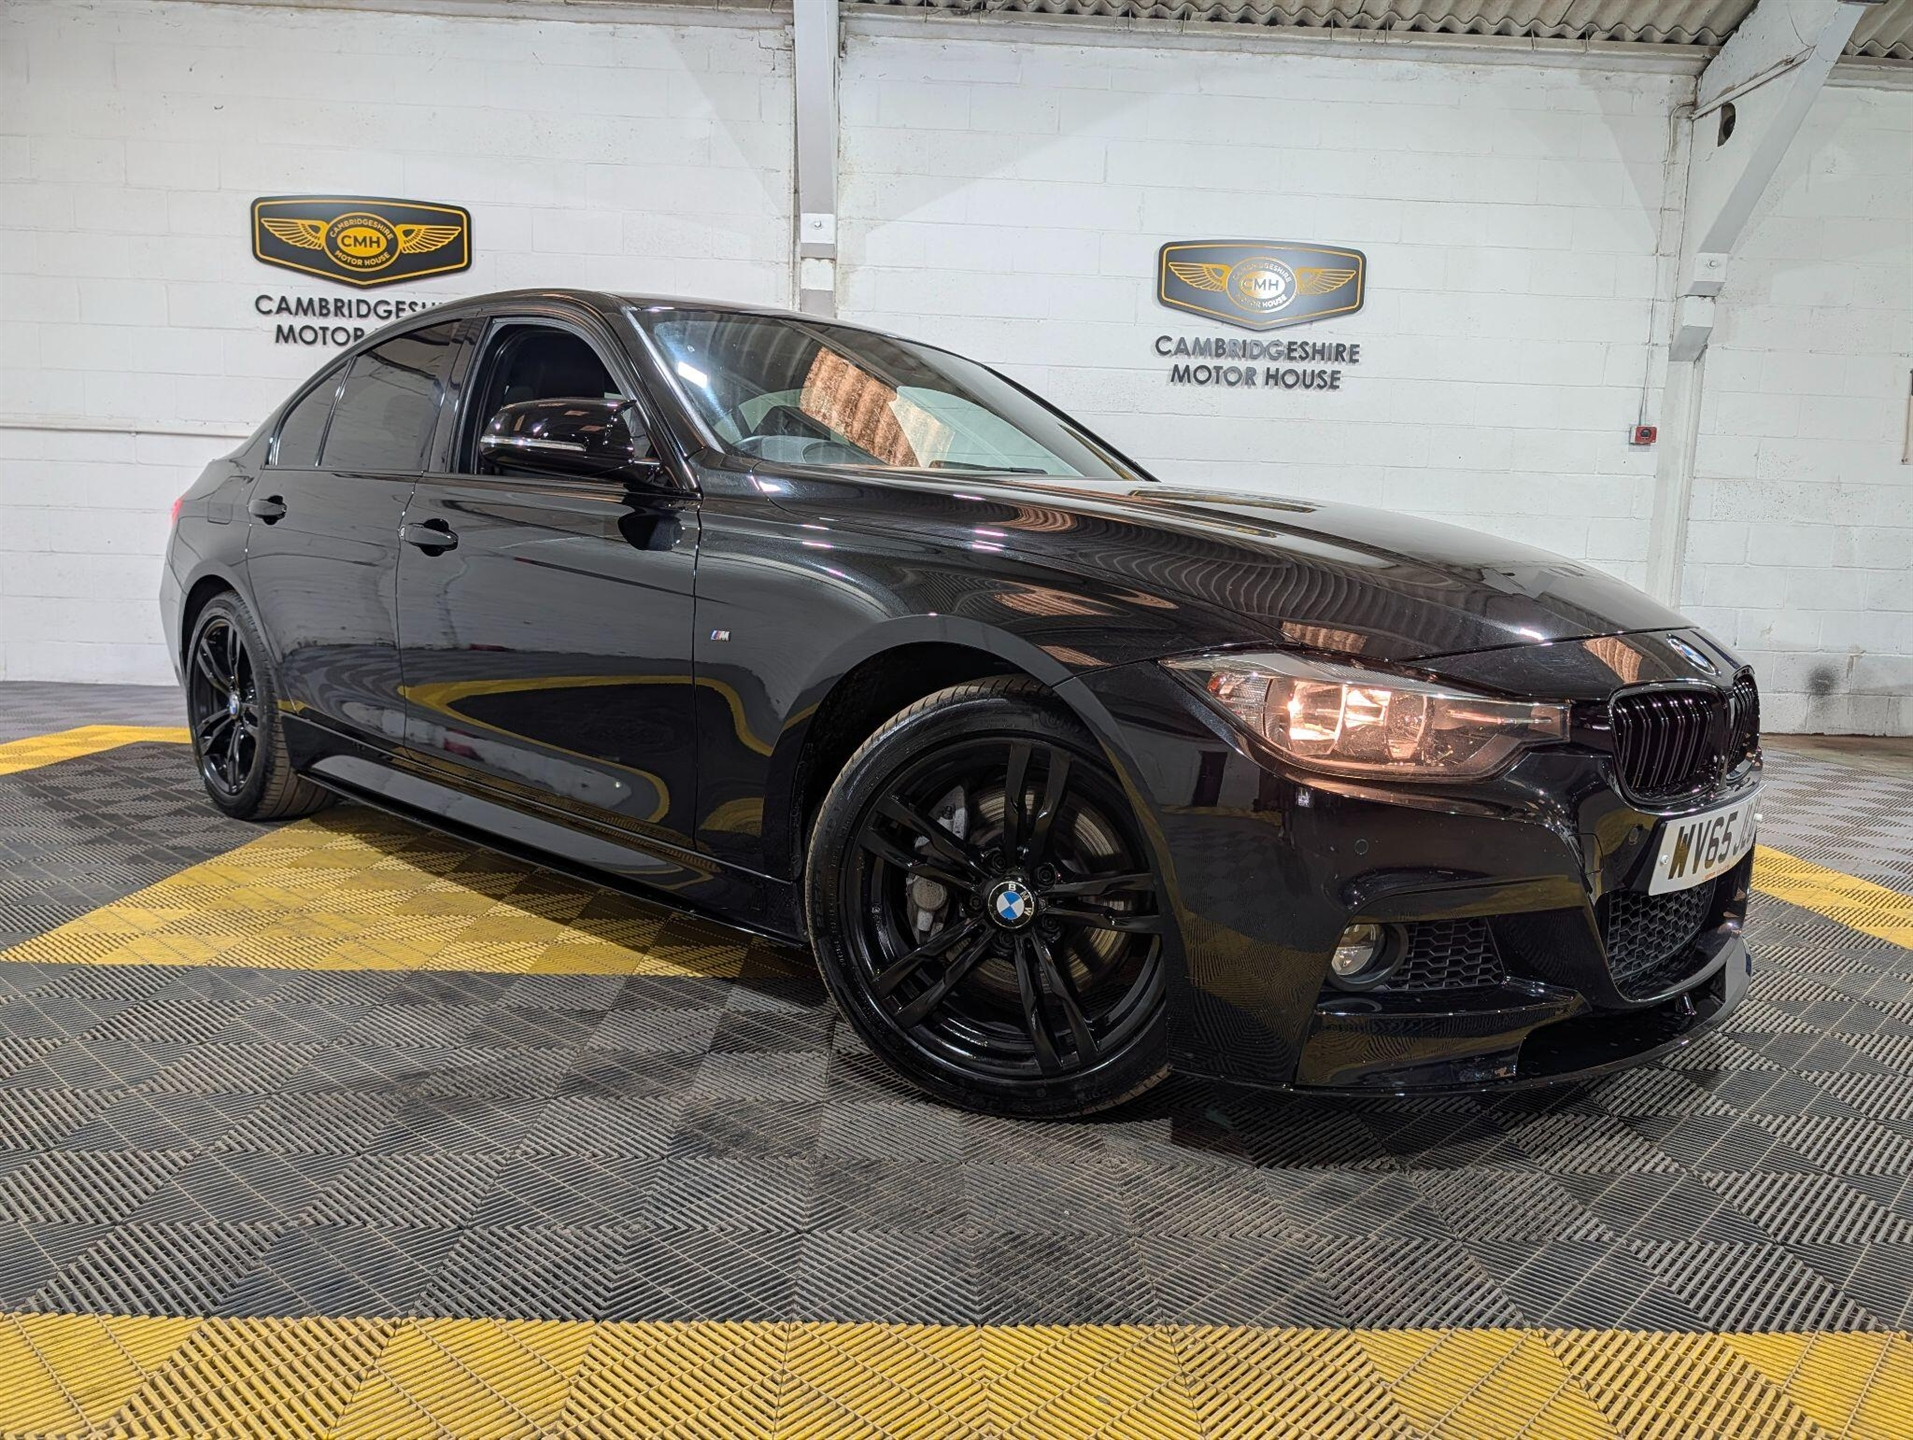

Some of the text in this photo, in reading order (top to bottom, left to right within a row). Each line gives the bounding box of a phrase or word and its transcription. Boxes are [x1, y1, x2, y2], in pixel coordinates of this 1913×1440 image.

[329, 218, 394, 240] CAMBRIDGESHIRE
[341, 234, 381, 249] CMH
[334, 250, 391, 266] MOTOR HOUSE
[1242, 278, 1280, 291] CMH
[255, 294, 443, 321] CAMBRIDGES
[1262, 293, 1288, 308] HOUSE
[1155, 335, 1361, 363] CAMBRIDGESHIRE
[1170, 364, 1342, 389] MOTOR HOUSE
[1668, 811, 1739, 880] WV65
